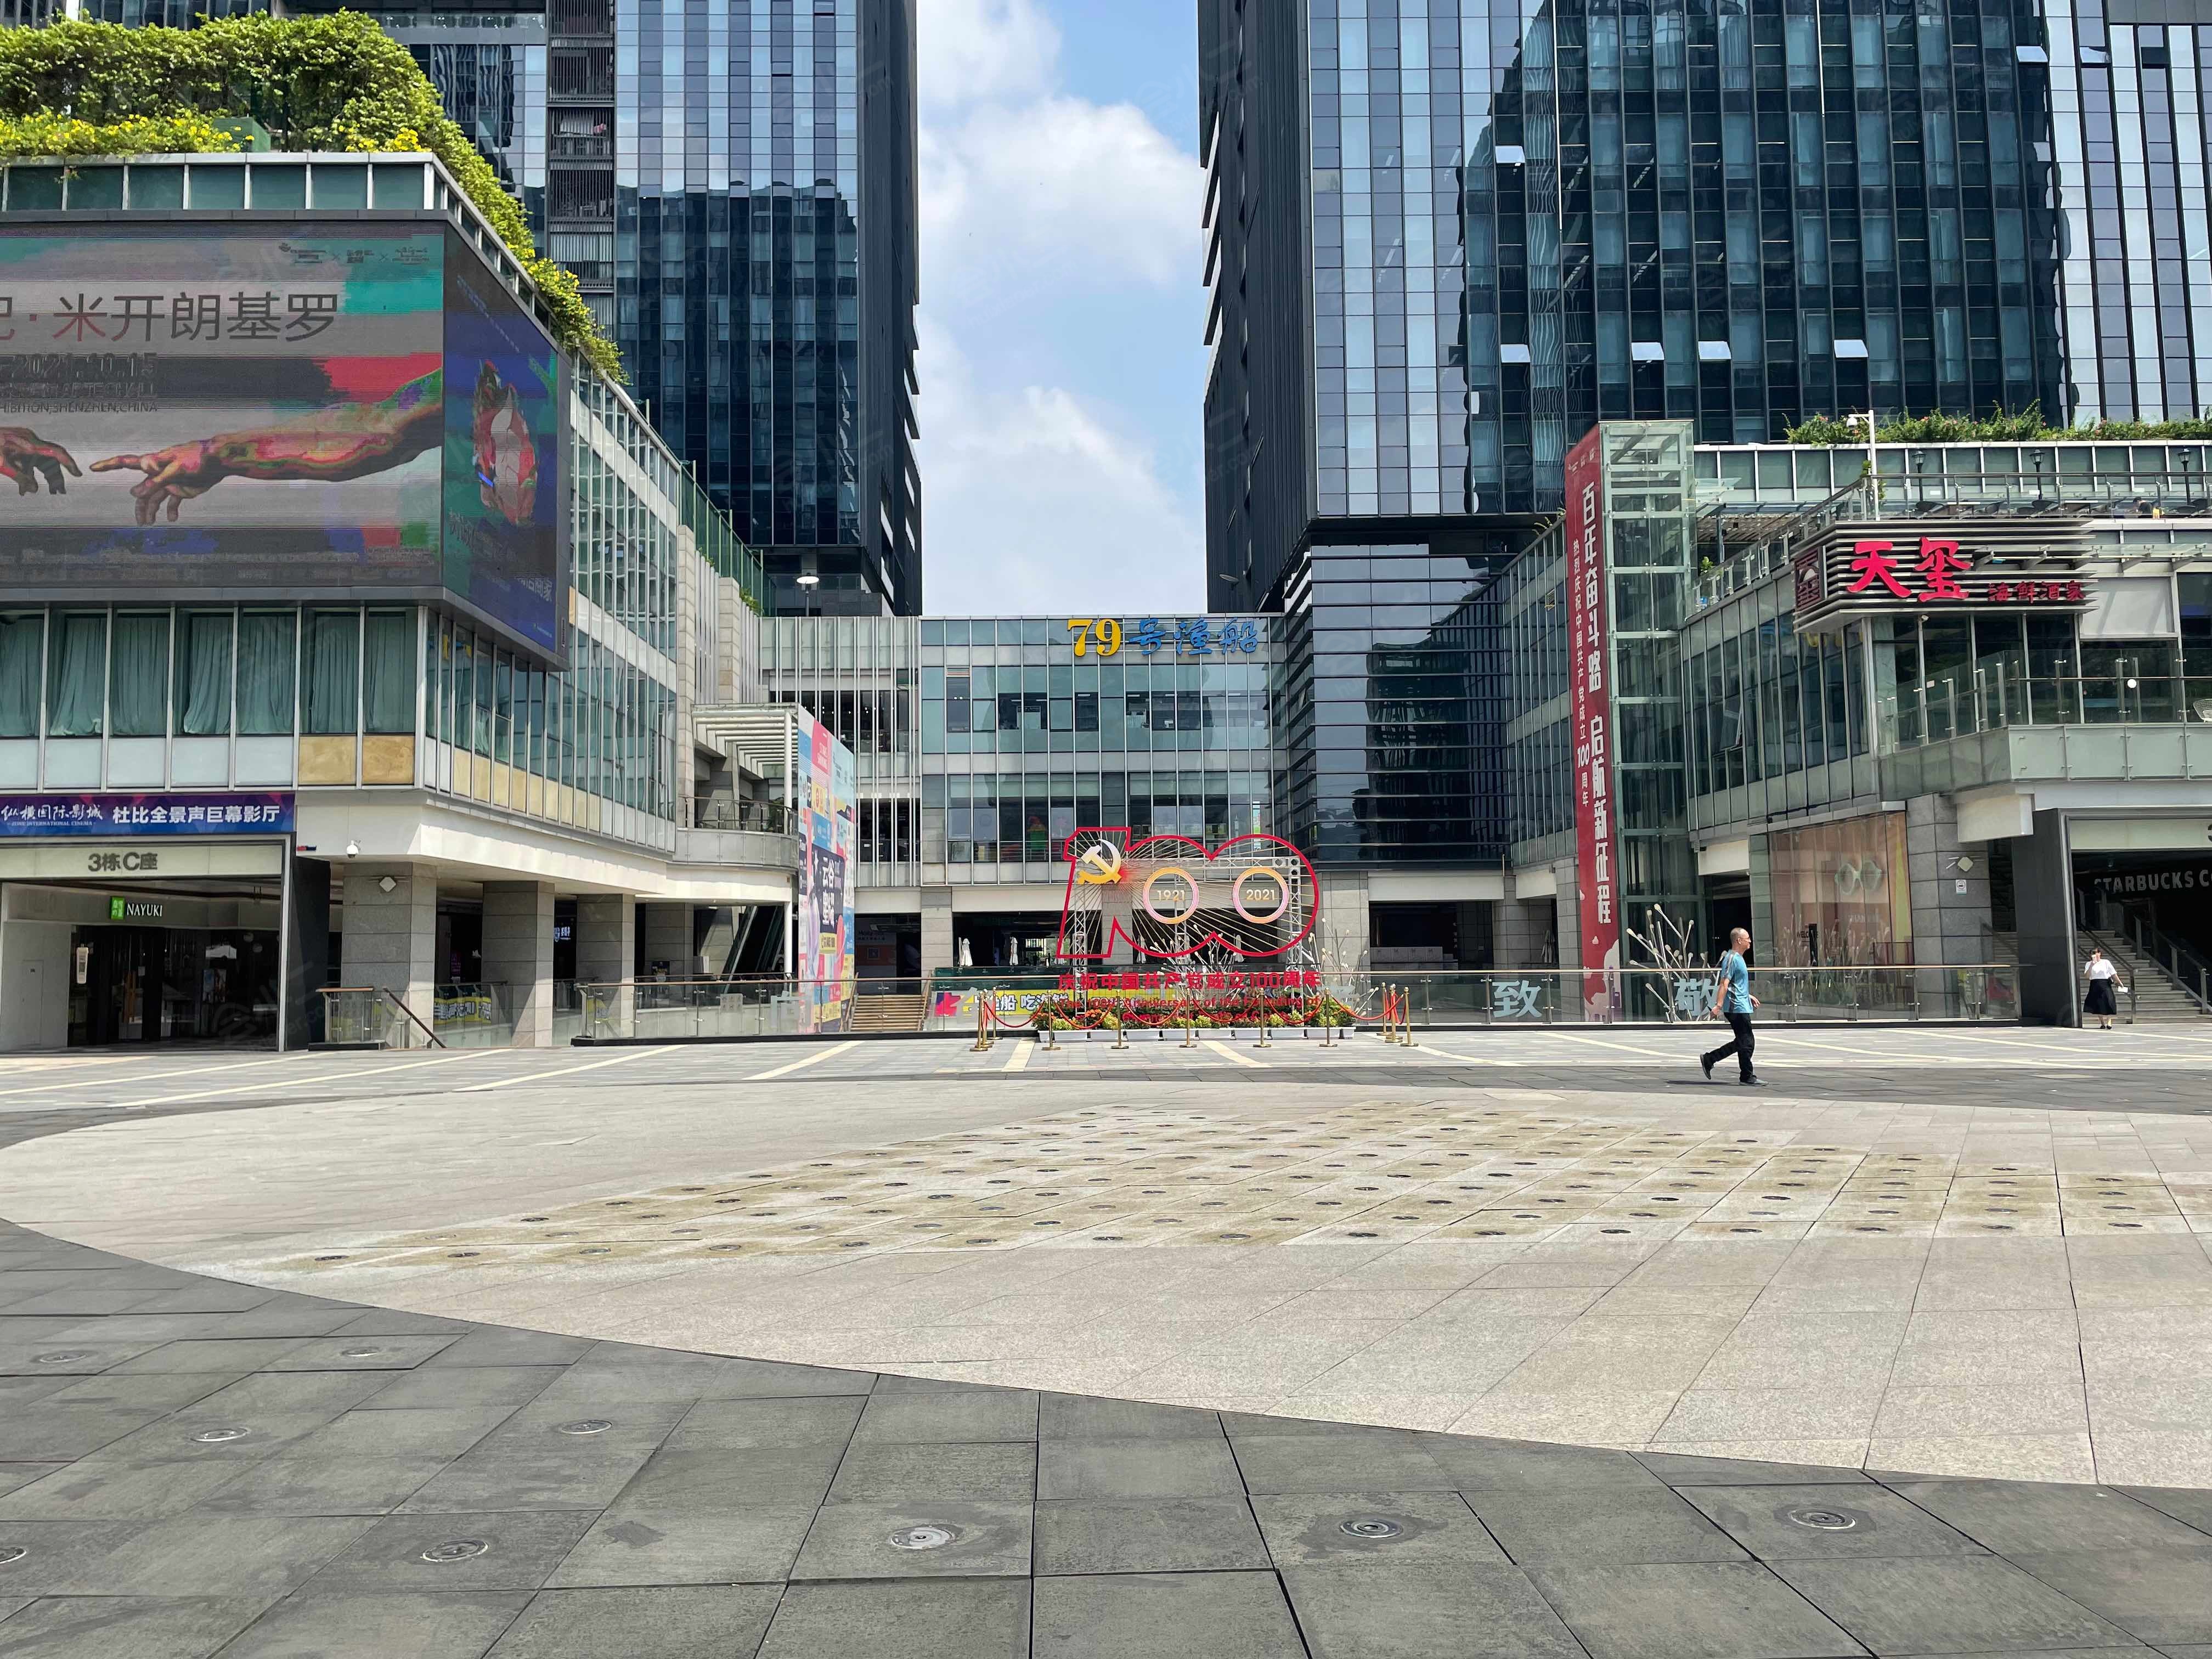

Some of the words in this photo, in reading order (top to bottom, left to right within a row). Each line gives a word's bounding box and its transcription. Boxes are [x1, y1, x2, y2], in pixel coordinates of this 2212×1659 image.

[1846, 536, 1971, 602] 天玺
[1582, 481, 1602, 693] 百年奋斗路
[1067, 617, 1259, 657] 79号渔船
[112, 805, 280, 823] 杜比全景声巨幕影厅
[1590, 715, 1611, 924] 启航新征程
[88, 851, 158, 872] 3栋C座
[2094, 871, 2194, 894] TARBUCKS
[1157, 889, 1186, 901] 1921
[1246, 889, 1275, 901] 2021
[127, 903, 163, 917] NAYUKI
[1058, 970, 1322, 991] 庆祝中国共产党成立100周年
